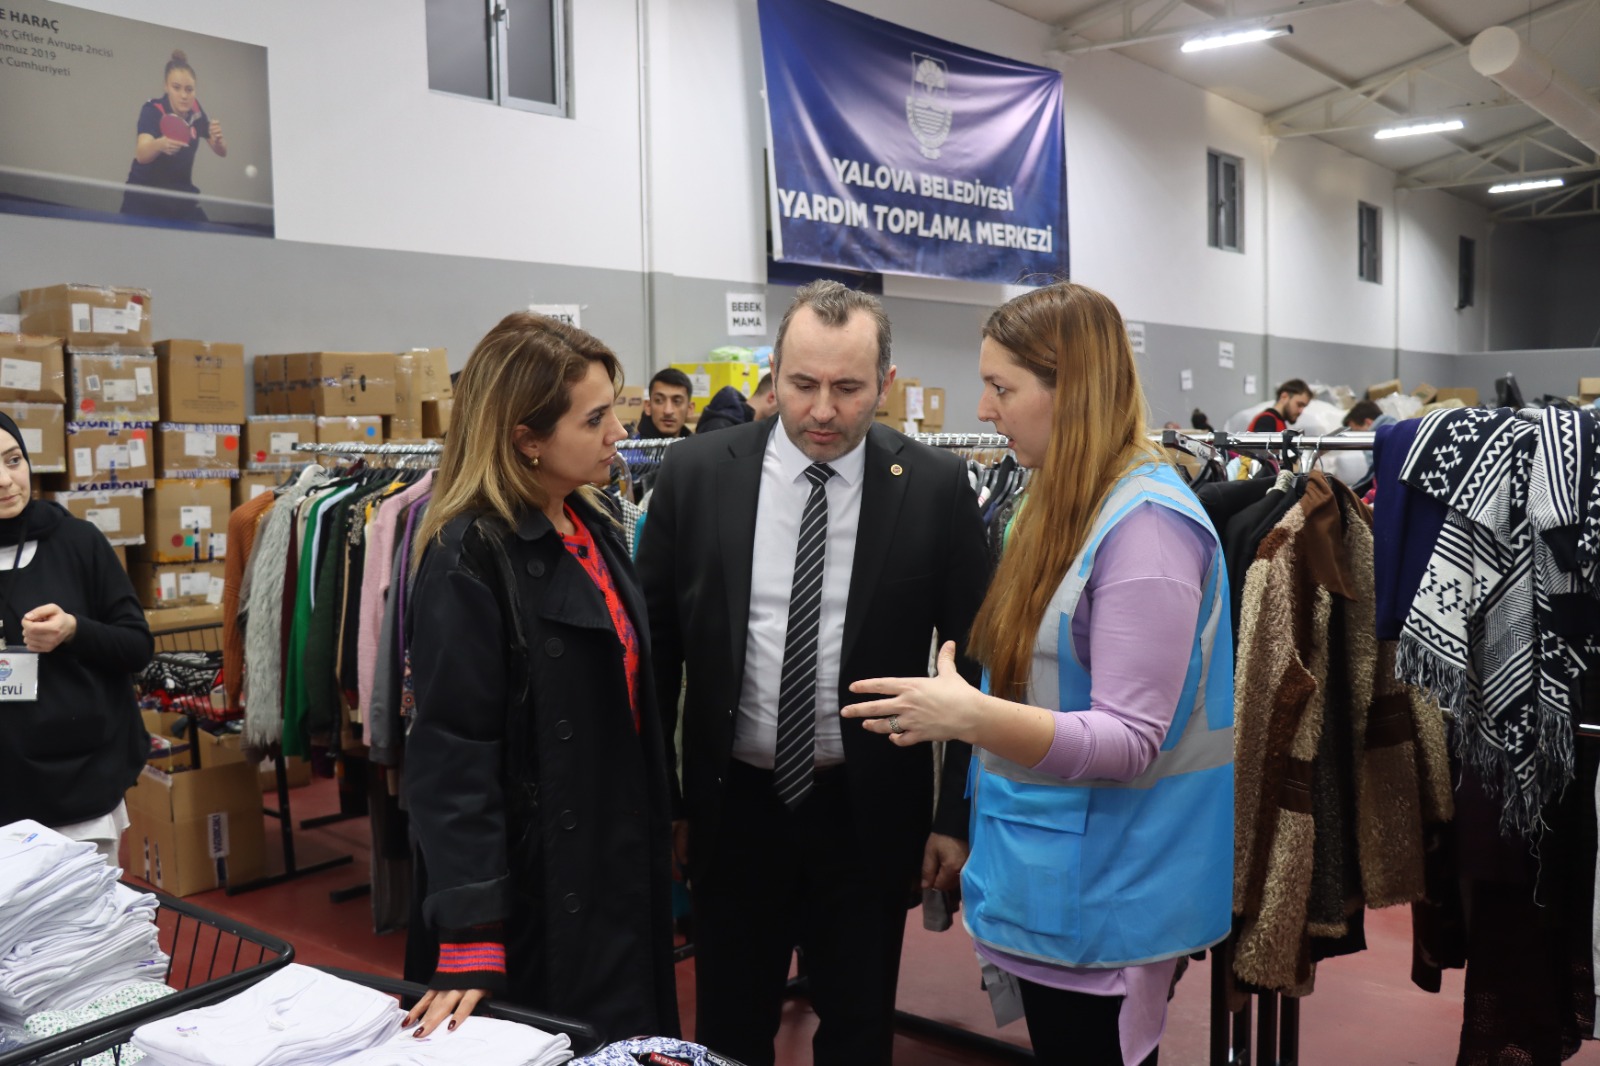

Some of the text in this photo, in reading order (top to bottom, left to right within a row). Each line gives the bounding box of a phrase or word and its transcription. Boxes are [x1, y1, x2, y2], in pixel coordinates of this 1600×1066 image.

[10, 10, 60, 34] HARAÇ
[47, 37, 84, 53] Avrupa
[31, 47, 57, 61] 2019
[6, 56, 71, 77] Cumhuriyeti
[832, 157, 1014, 211] YALOVA BELEDİYESİ
[778, 188, 1053, 253] YARDIM TOPLAMA MERKEZİ
[731, 301, 762, 312] BEBEK
[732, 317, 762, 327] MAMA
[0, 683, 22, 695] EVLİ
